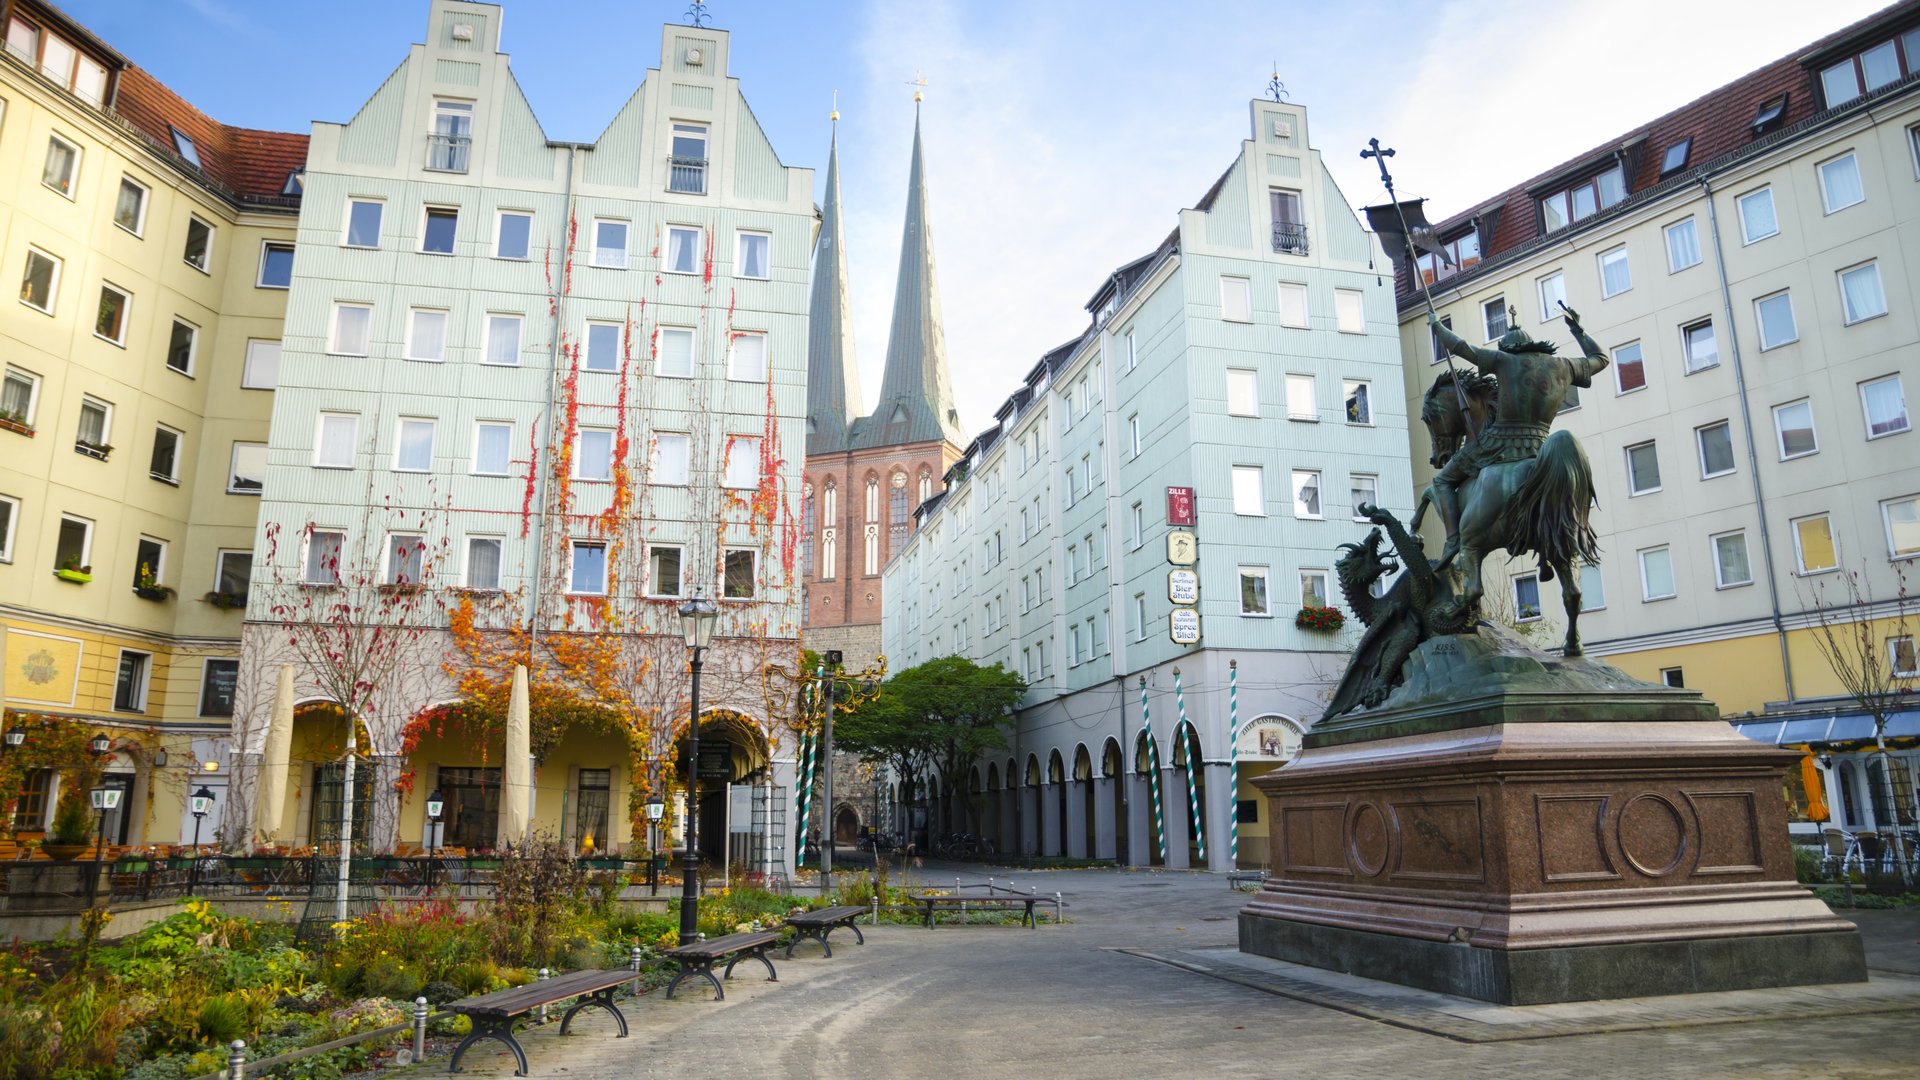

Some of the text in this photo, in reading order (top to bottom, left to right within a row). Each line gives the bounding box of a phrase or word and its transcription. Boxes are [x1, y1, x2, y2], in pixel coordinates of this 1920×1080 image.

[1174, 623, 1197, 631] Spree
[1176, 631, 1197, 639] Blick
[1257, 718, 1298, 735] GASTRONOMIE
